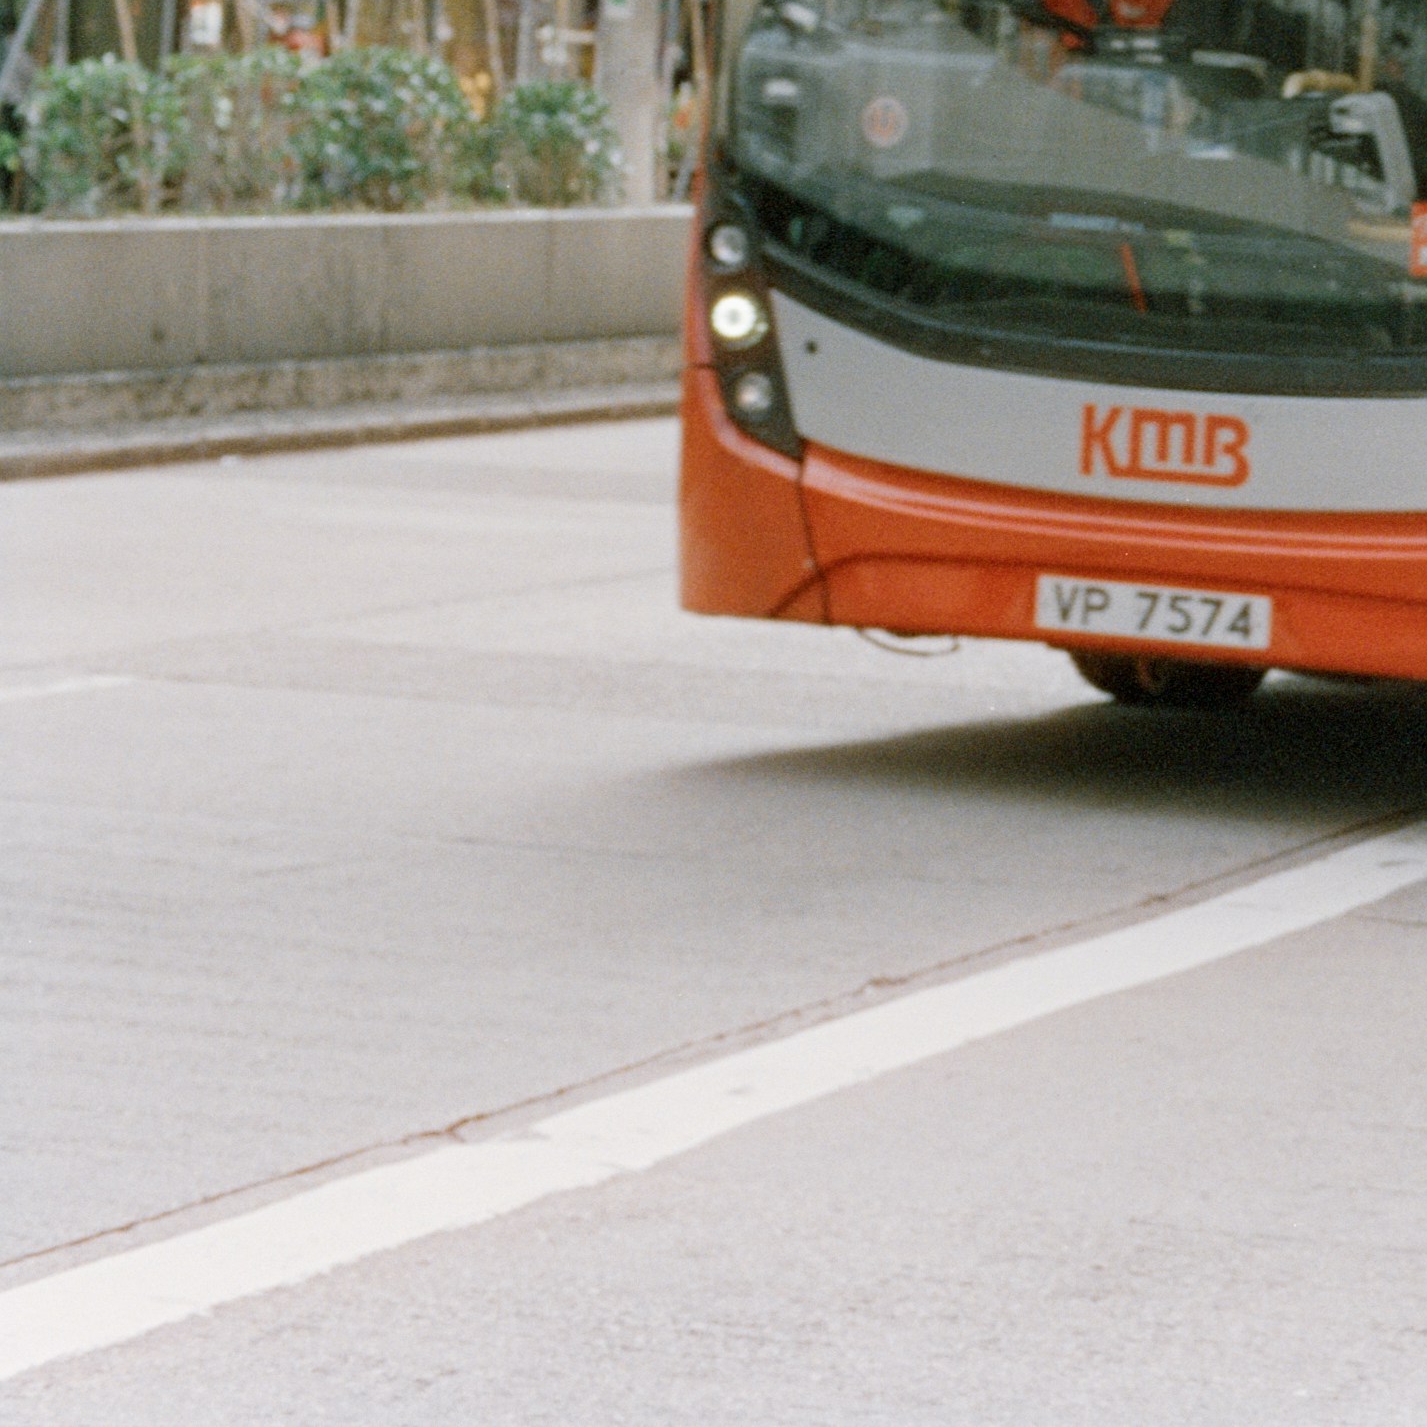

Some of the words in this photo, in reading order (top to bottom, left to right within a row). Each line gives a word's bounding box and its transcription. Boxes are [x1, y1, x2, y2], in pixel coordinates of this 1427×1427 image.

[1079, 402, 1252, 490] KMB
[1053, 582, 1111, 625] VP
[1135, 590, 1253, 640] 7574
